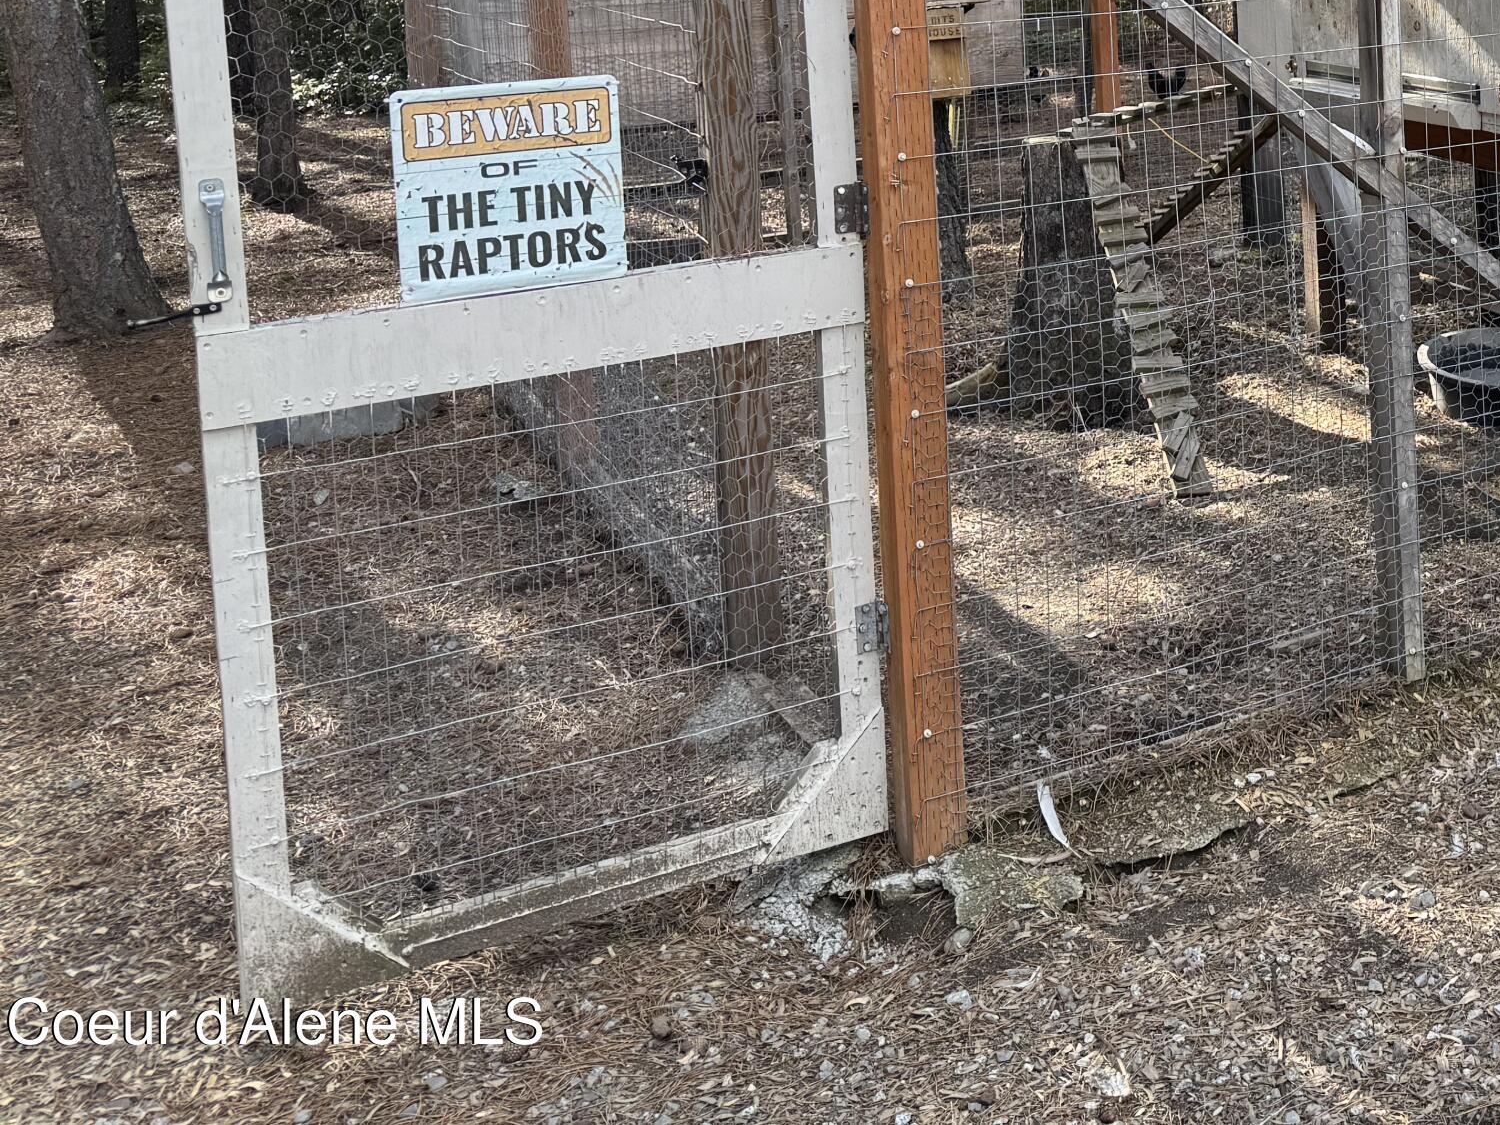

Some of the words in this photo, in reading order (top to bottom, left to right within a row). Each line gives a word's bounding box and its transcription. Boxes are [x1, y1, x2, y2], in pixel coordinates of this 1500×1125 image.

[412, 98, 601, 149] BEWARE
[480, 159, 538, 179] OF
[421, 189, 498, 233] THE
[510, 178, 597, 223] TINY
